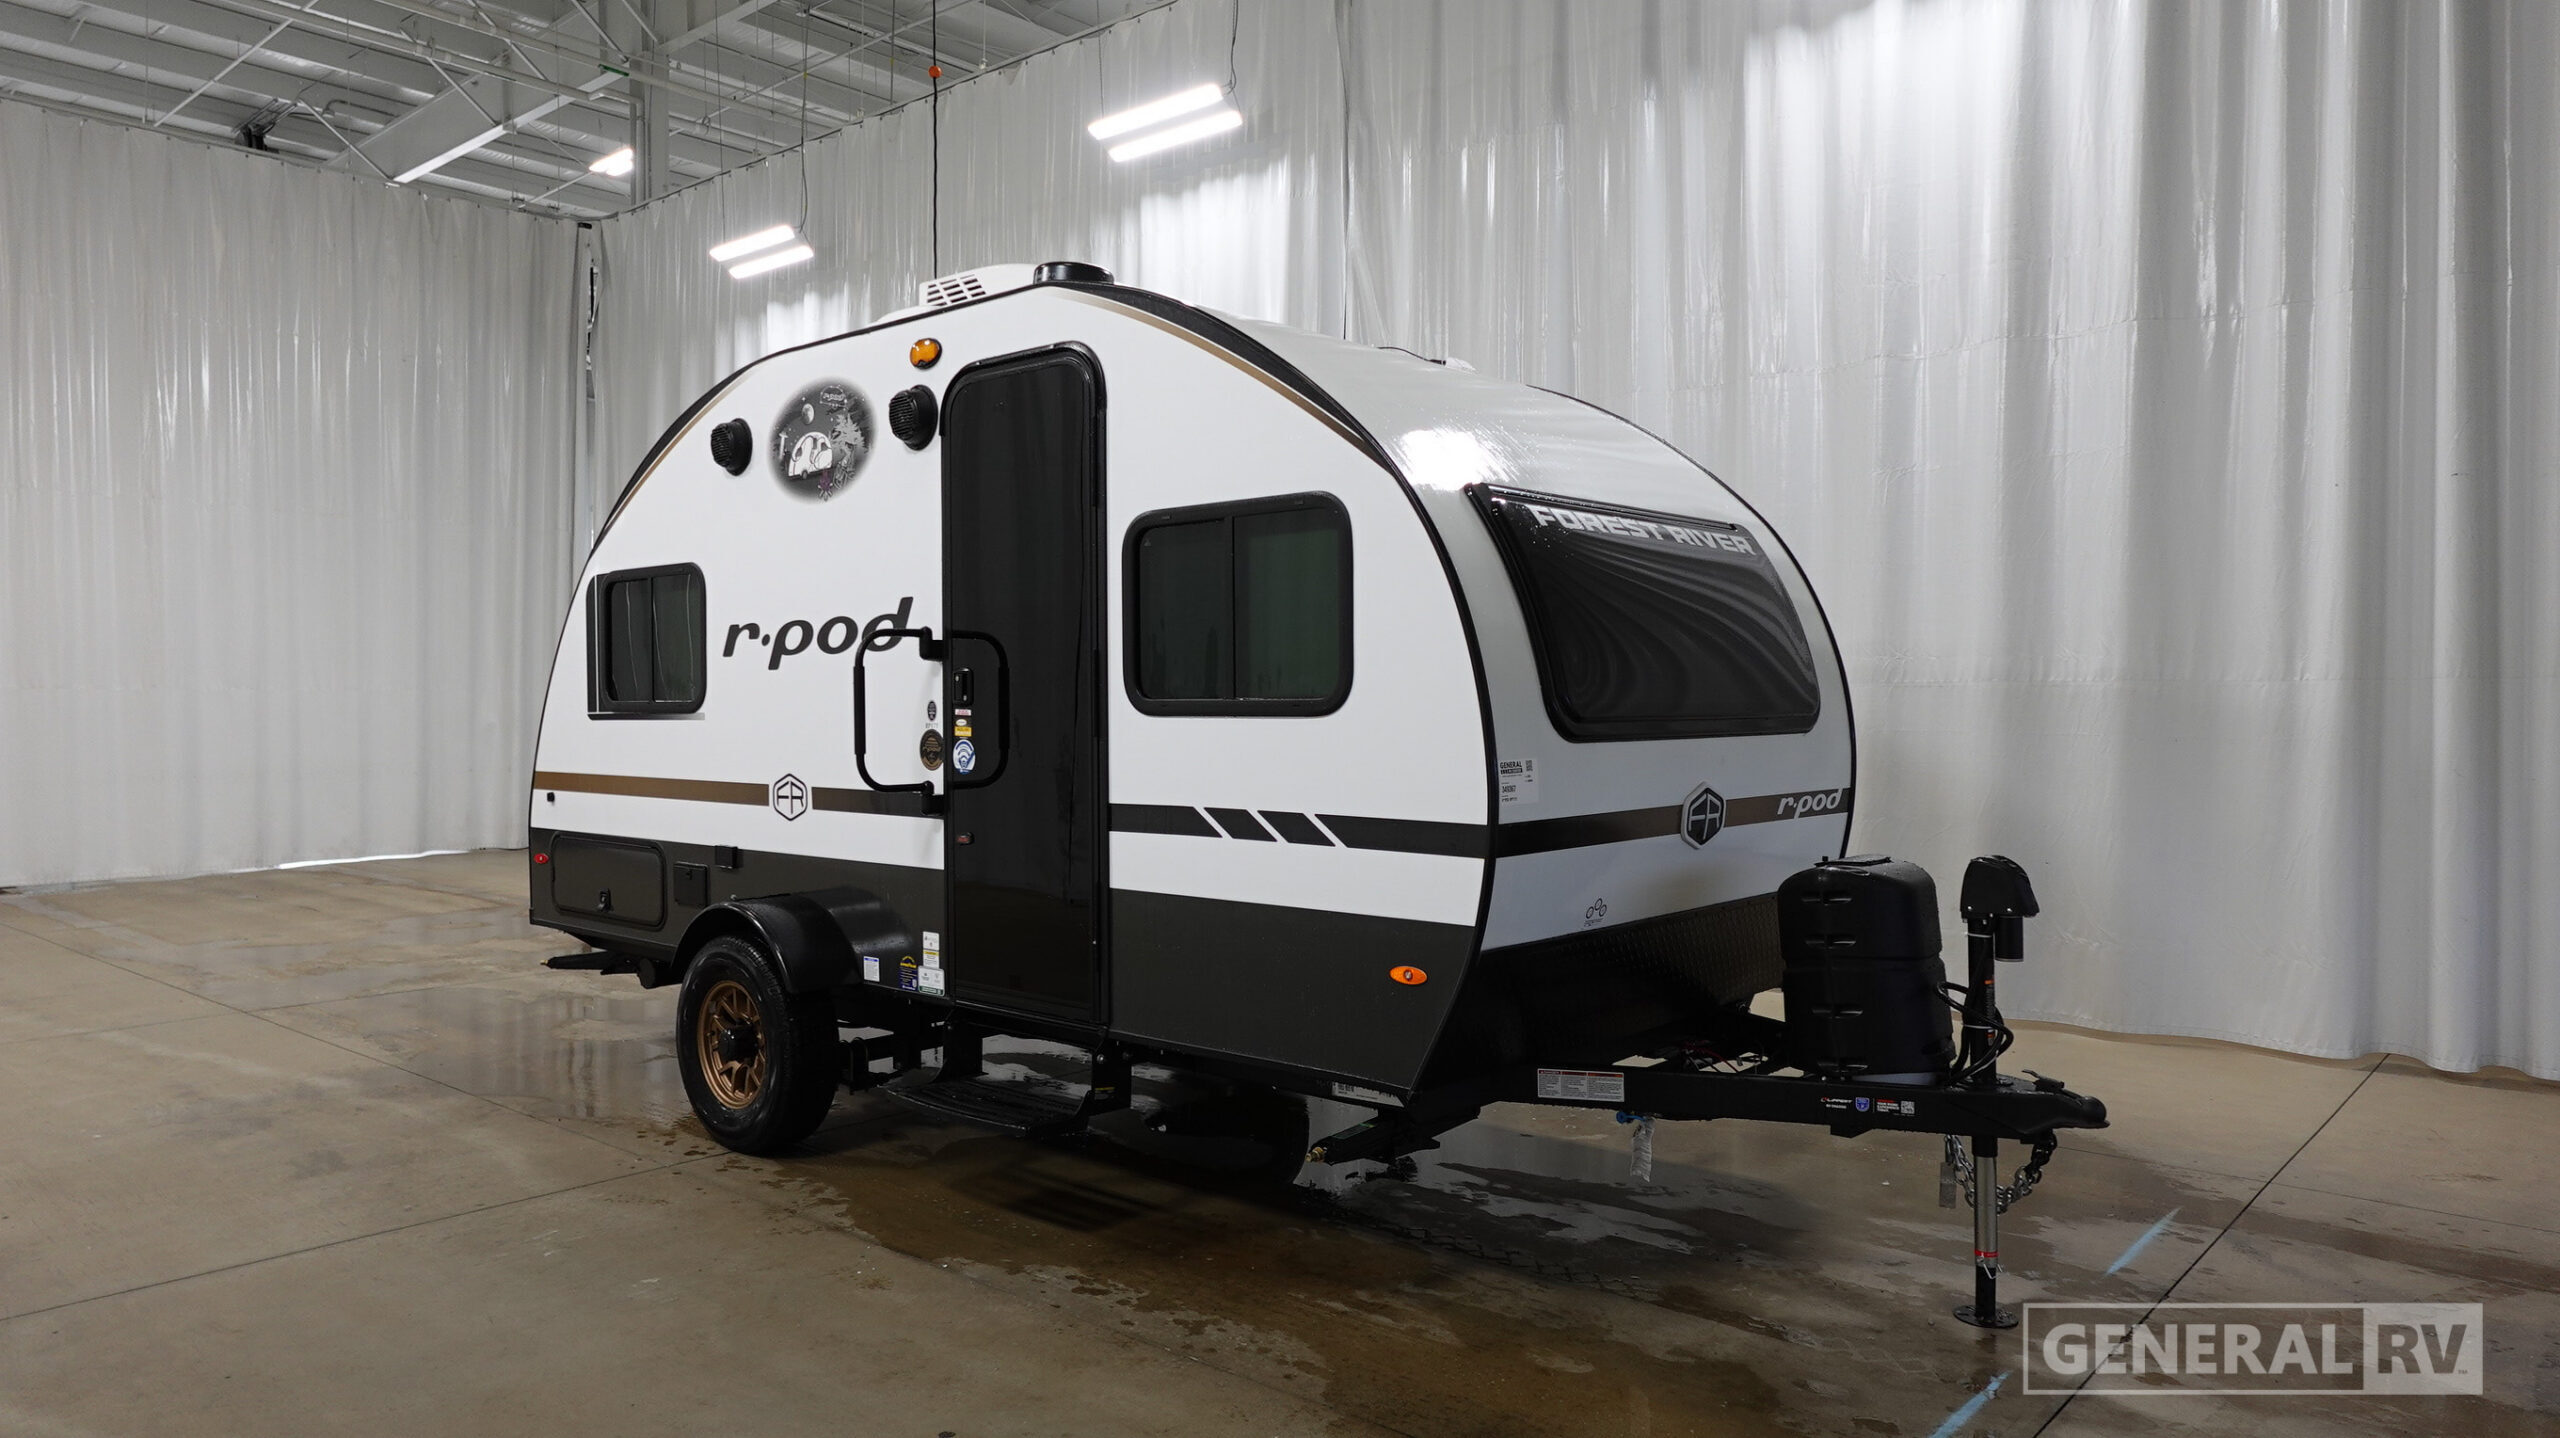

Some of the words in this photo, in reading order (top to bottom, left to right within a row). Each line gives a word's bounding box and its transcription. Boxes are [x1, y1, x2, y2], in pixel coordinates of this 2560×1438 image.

[1530, 505, 1665, 540] FOREST
[1668, 527, 1756, 555] RIVER
[1500, 760, 1522, 769] GENERAL
